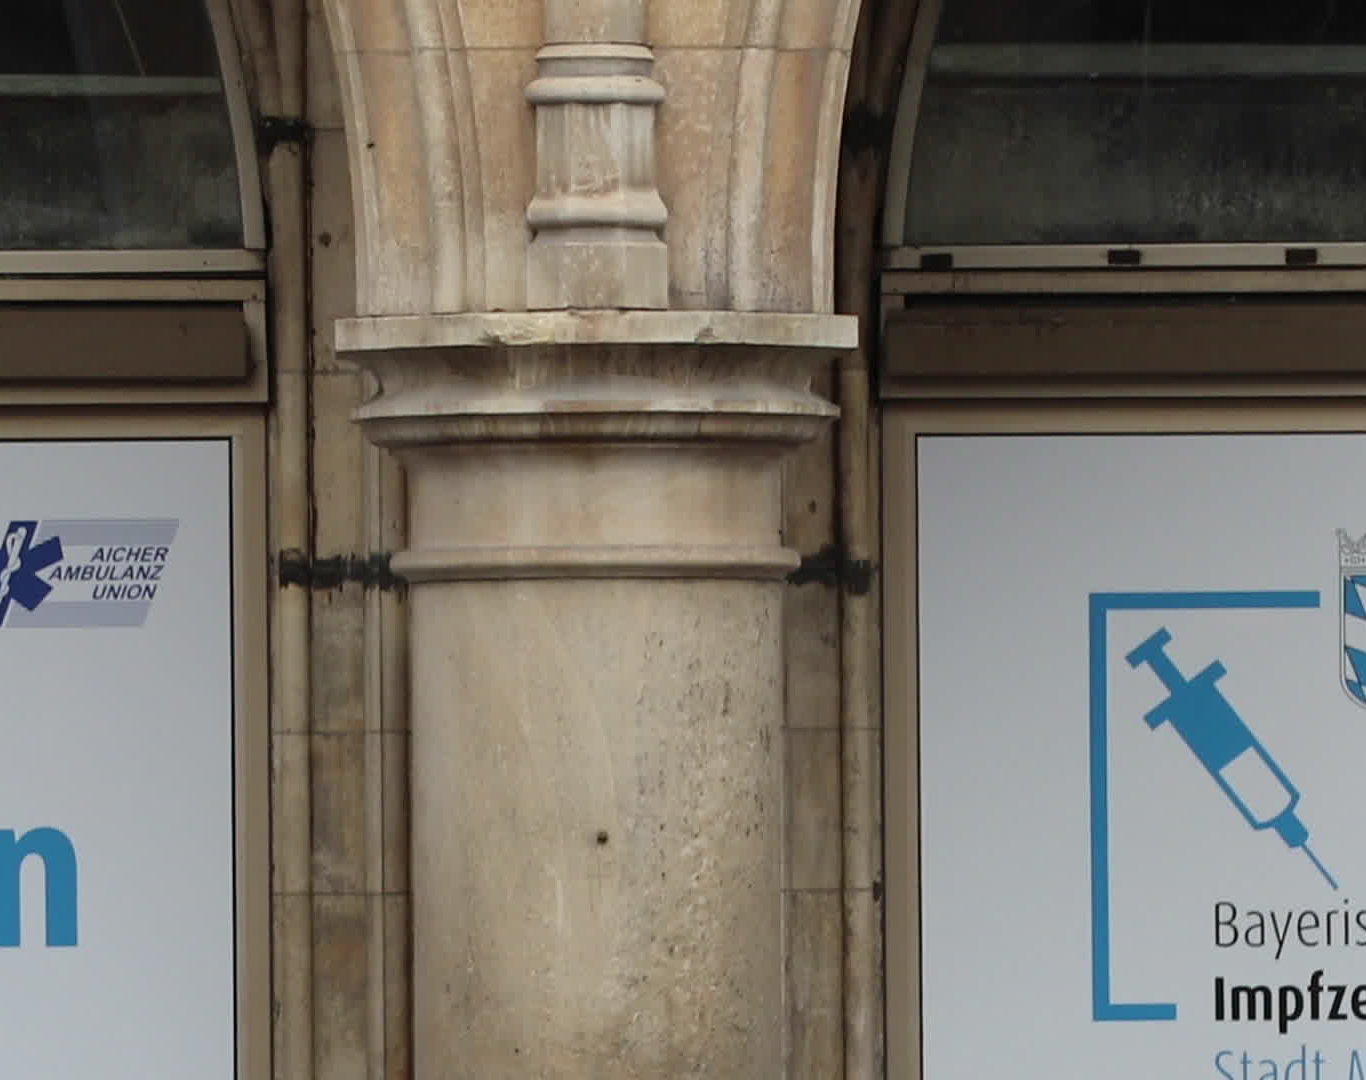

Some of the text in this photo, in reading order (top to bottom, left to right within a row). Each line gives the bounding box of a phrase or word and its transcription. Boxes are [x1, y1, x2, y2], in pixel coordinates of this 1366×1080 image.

[91, 547, 169, 563] AICHER
[48, 565, 163, 581] AMBULANZ
[92, 584, 157, 600] UNION
